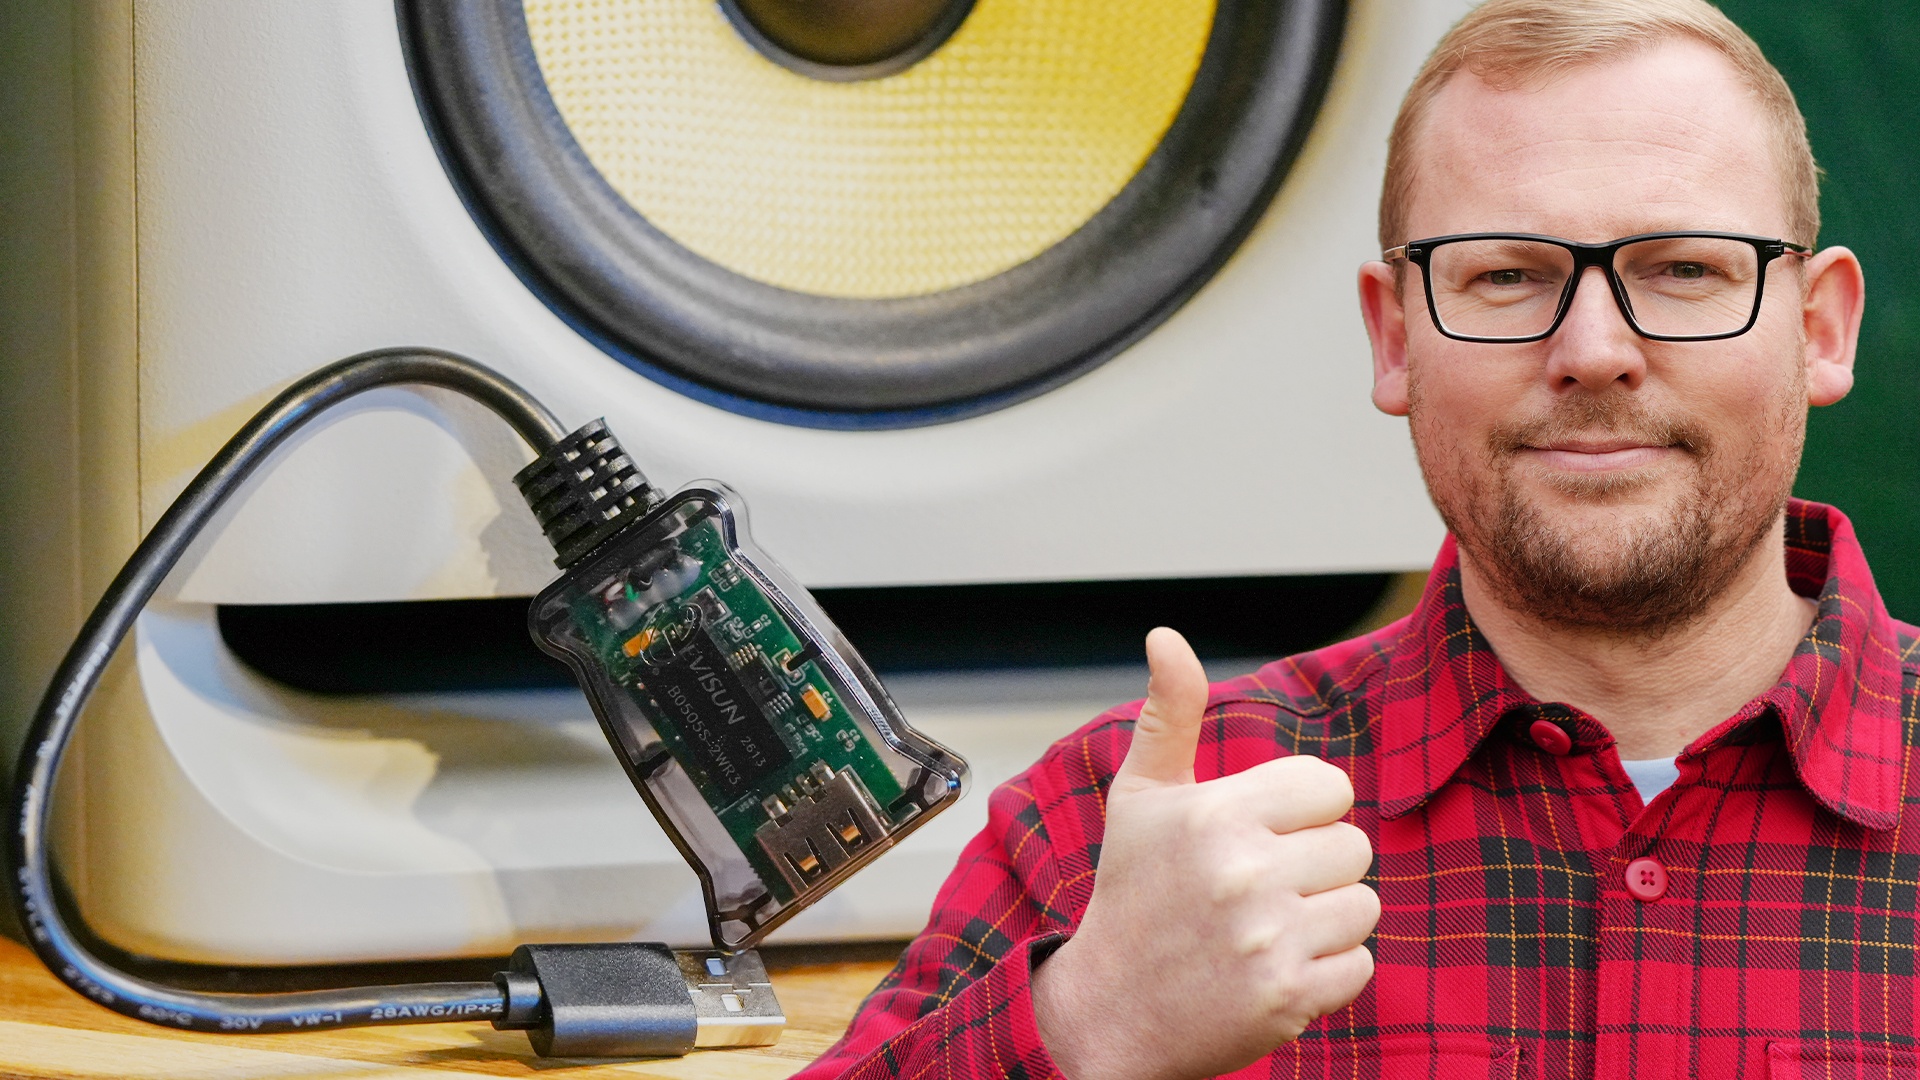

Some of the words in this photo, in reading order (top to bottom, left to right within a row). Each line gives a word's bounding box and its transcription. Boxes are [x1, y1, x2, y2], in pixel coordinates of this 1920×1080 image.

[760, 614, 772, 627] C2
[821, 690, 834, 704] C4
[667, 685, 742, 785] B0505S-2WR3
[740, 735, 767, 767] 2613
[220, 1015, 264, 1030] 30V
[291, 1013, 342, 1027] VW-1
